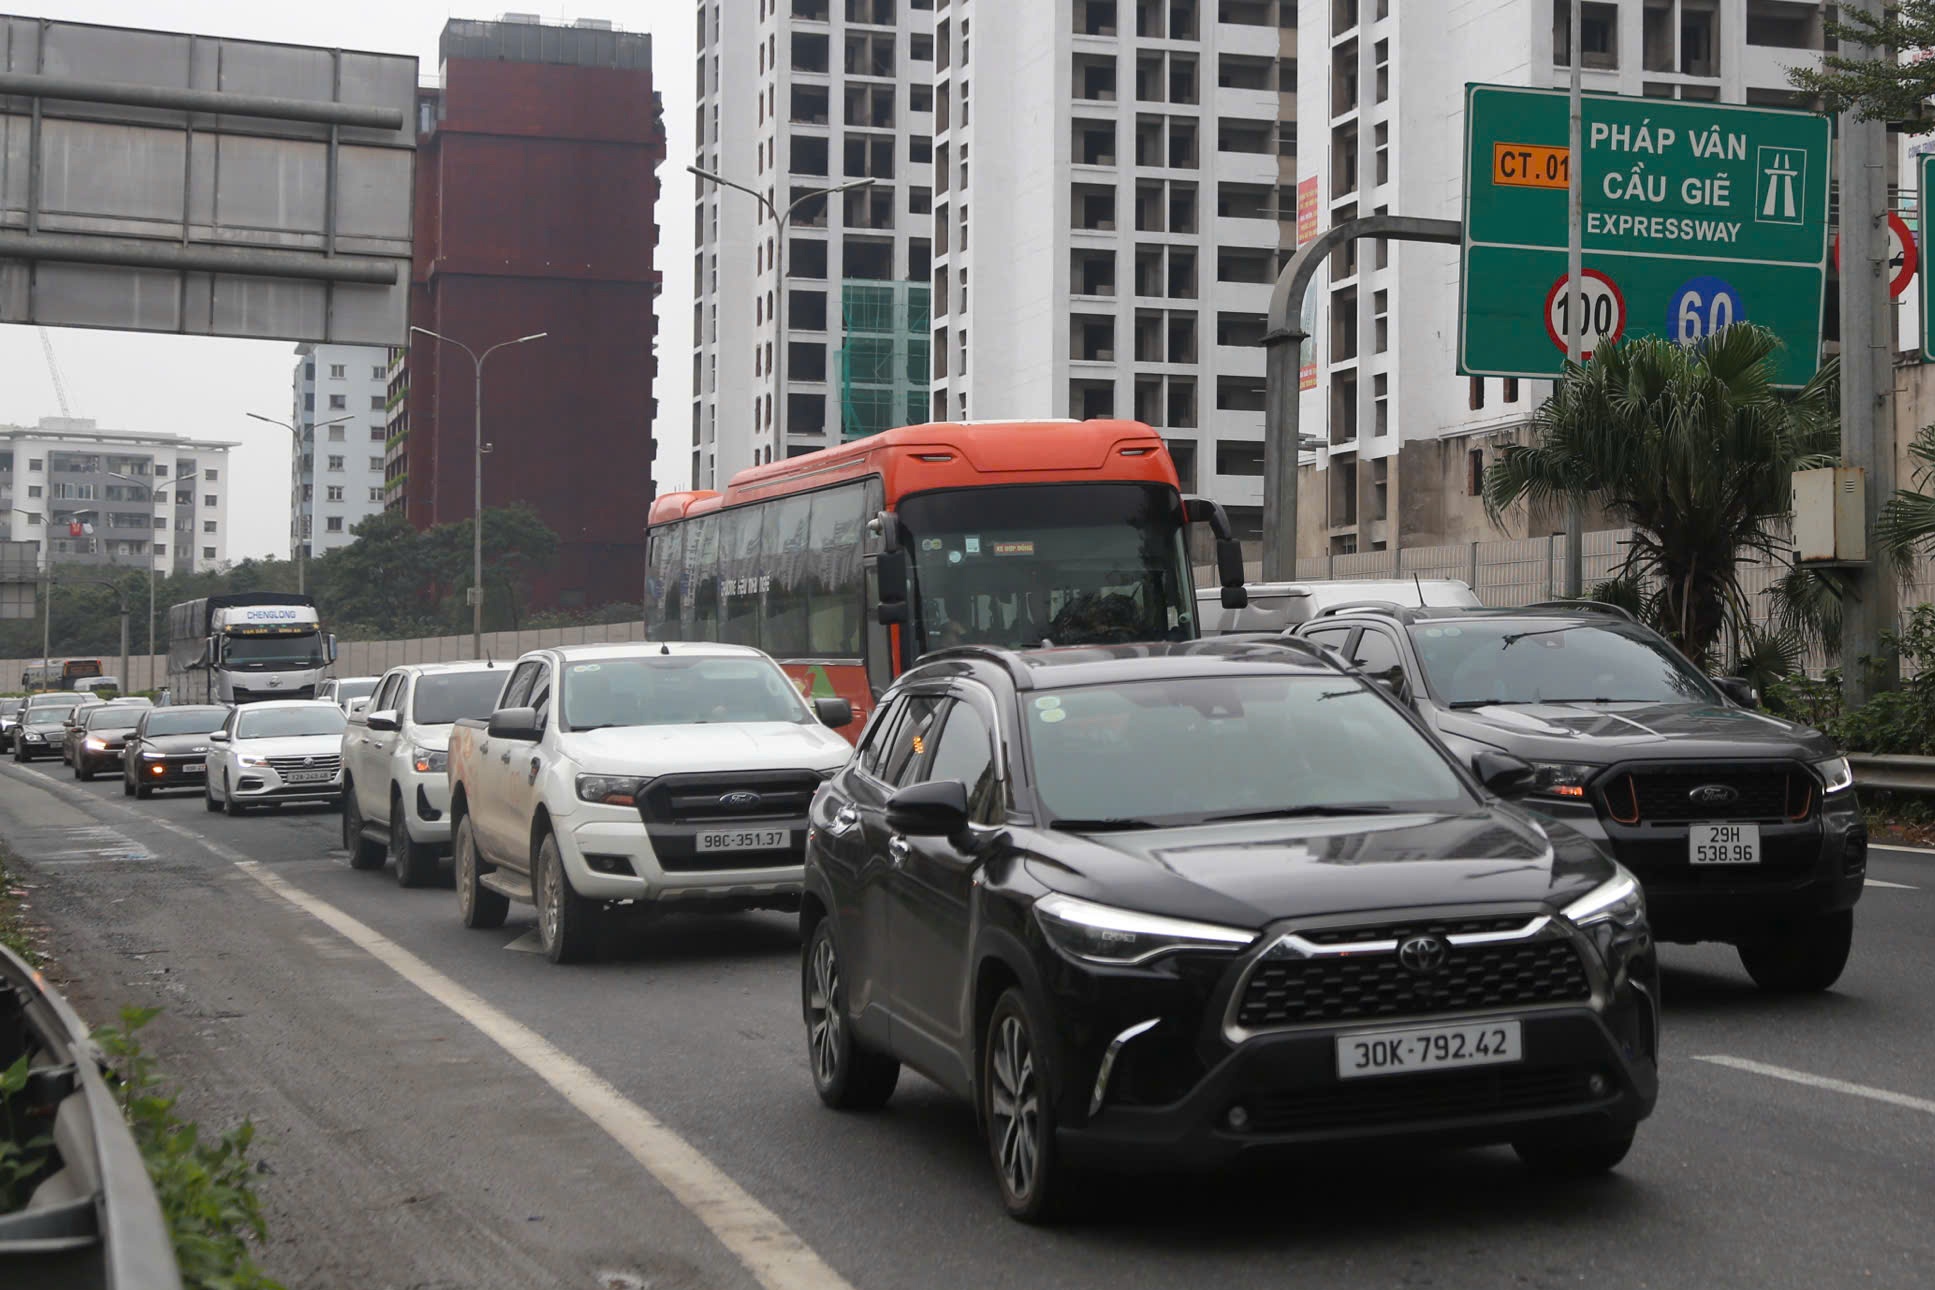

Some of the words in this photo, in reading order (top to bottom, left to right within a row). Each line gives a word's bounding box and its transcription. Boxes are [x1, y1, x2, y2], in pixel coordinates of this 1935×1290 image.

[1590, 118, 1676, 155] PHÁP
[1688, 124, 1747, 161] VÂN
[1500, 150, 1570, 182] CT.01
[1602, 161, 1667, 203] CẦU
[1681, 172, 1731, 207] GIẼ
[1586, 212, 1742, 243] EXPRESSWAY
[1678, 290, 1733, 347] 60
[247, 610, 296, 620] CHENGLONG
[730, 792, 754, 804] Ford
[1702, 787, 1729, 801] Ford
[704, 832, 783, 848] 98C-351.37
[1710, 827, 1740, 843] 29H
[1697, 845, 1753, 862] 538.96
[1354, 1030, 1507, 1069] 30K-792.42
